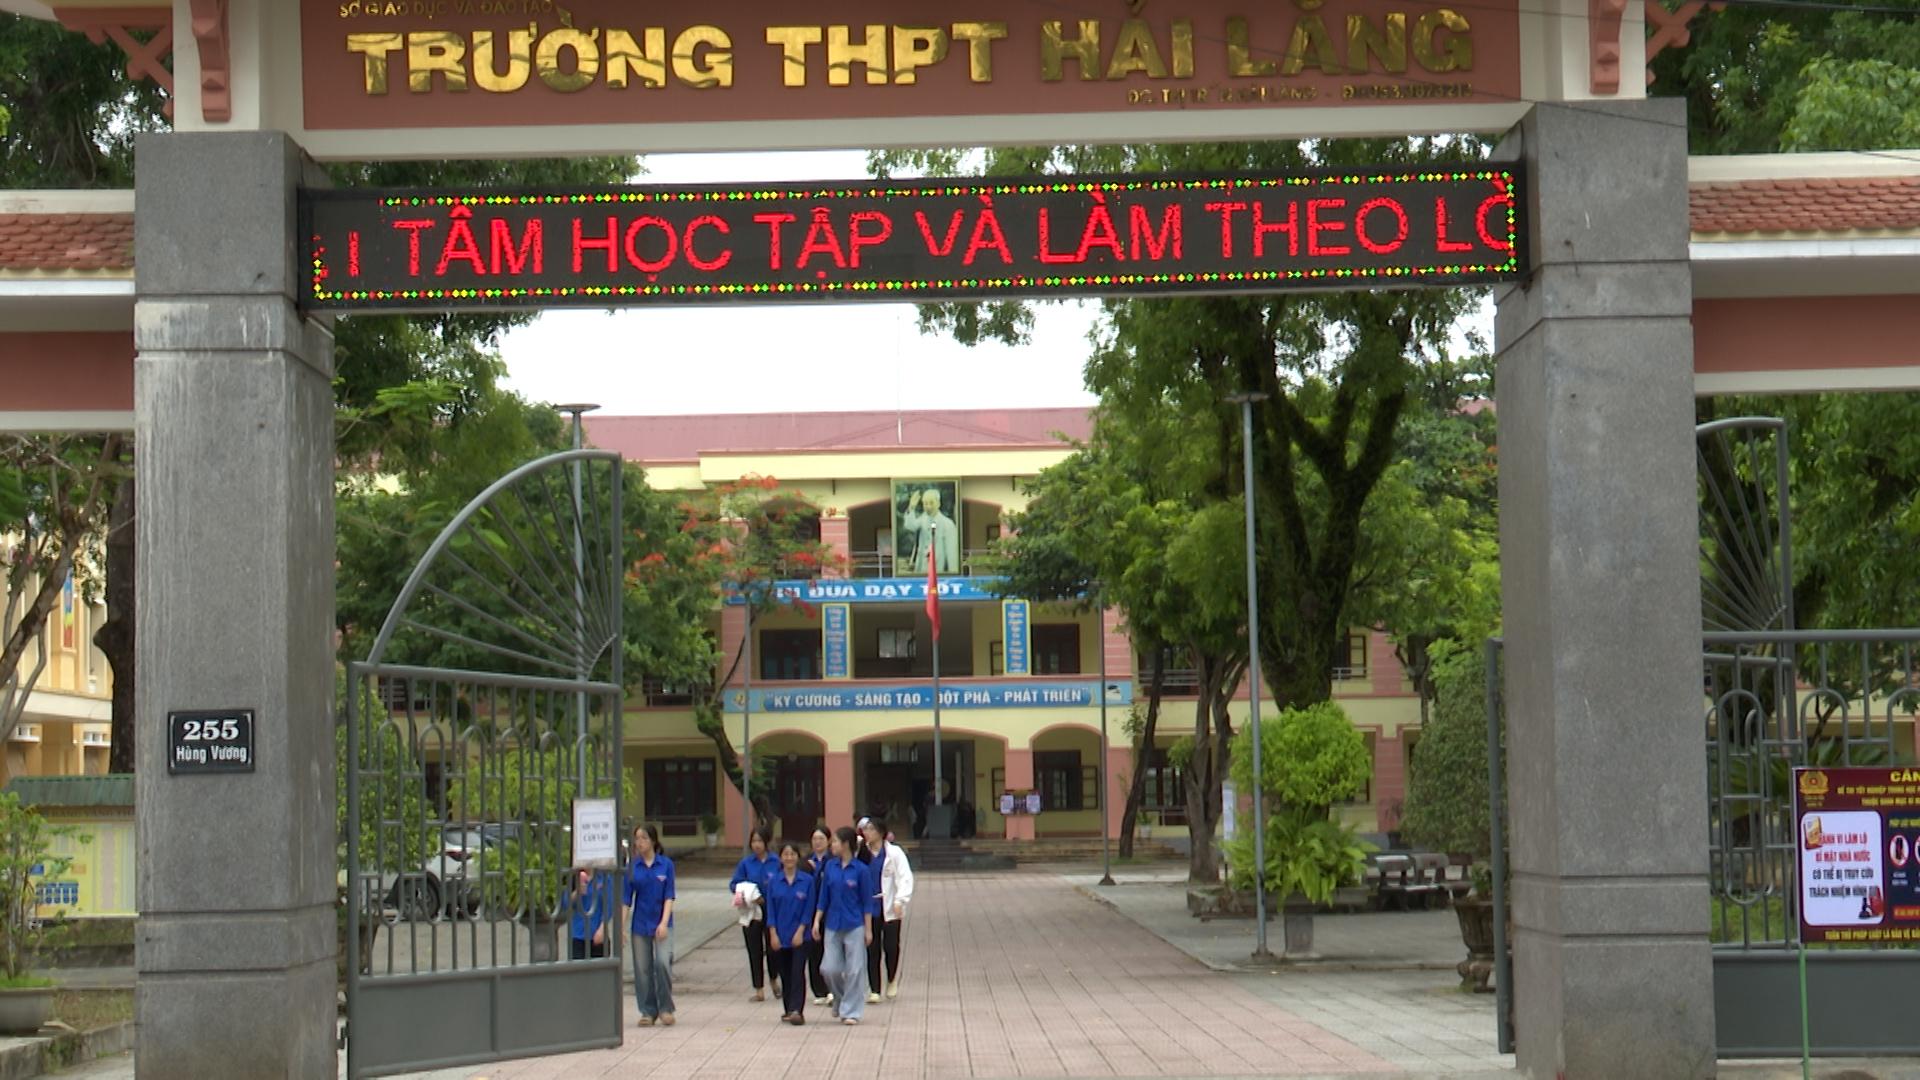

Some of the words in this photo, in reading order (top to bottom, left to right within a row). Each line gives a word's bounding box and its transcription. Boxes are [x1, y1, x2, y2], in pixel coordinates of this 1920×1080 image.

[346, 8, 733, 95] TRƯỜNG
[766, 22, 1008, 87] THPT
[1040, 0, 1195, 82] HẢI
[1226, 0, 1474, 78] LĂNG
[392, 205, 542, 277] TÂM
[572, 216, 732, 283] HỌC
[753, 206, 893, 279] TẬP
[914, 196, 1013, 266] VÀ
[1034, 193, 1183, 264] LÀM
[1204, 197, 1409, 259] THEO
[864, 583, 913, 599] DẠY
[855, 691, 893, 706] SÁNG
[895, 692, 922, 708] TẠO
[1003, 687, 1038, 703] PHÁT
[183, 719, 240, 741] 255
[176, 745, 207, 765] Hùng
[210, 745, 247, 763] Vương
